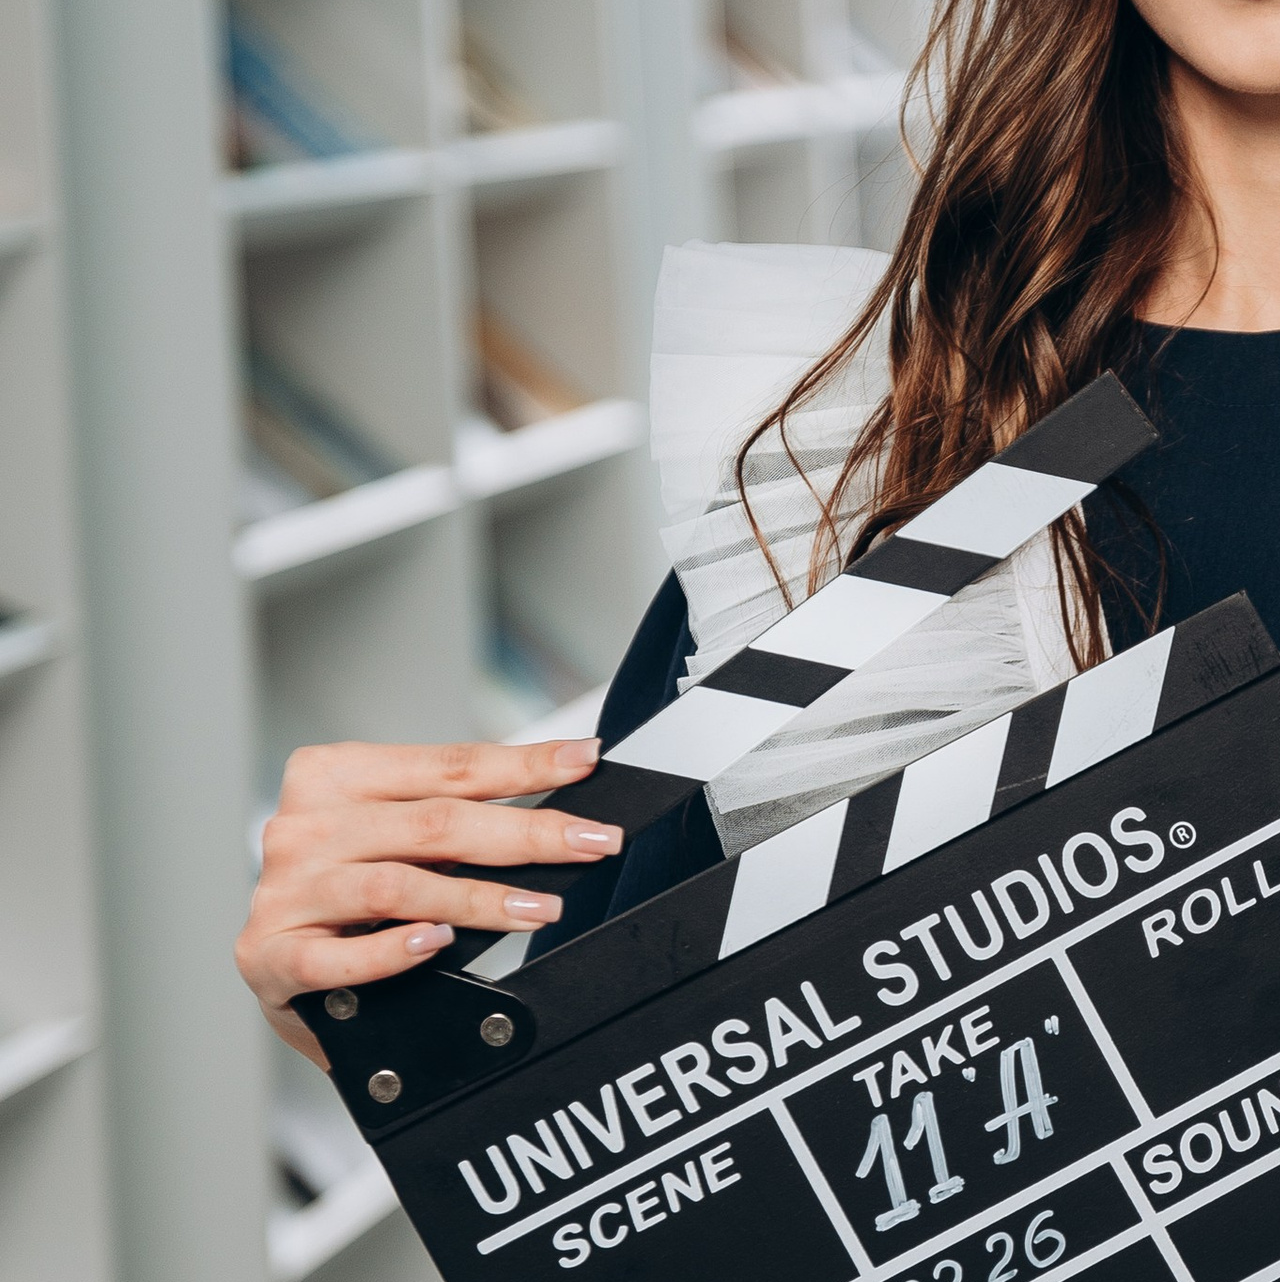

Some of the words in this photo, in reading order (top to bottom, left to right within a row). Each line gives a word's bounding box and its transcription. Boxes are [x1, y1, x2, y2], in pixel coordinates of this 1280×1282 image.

[457, 980, 863, 1216] UNIVERSAL
[852, 1004, 1001, 1108] TAKE
[552, 1141, 742, 1270] SCENE
[854, 1090, 966, 1232] 11
